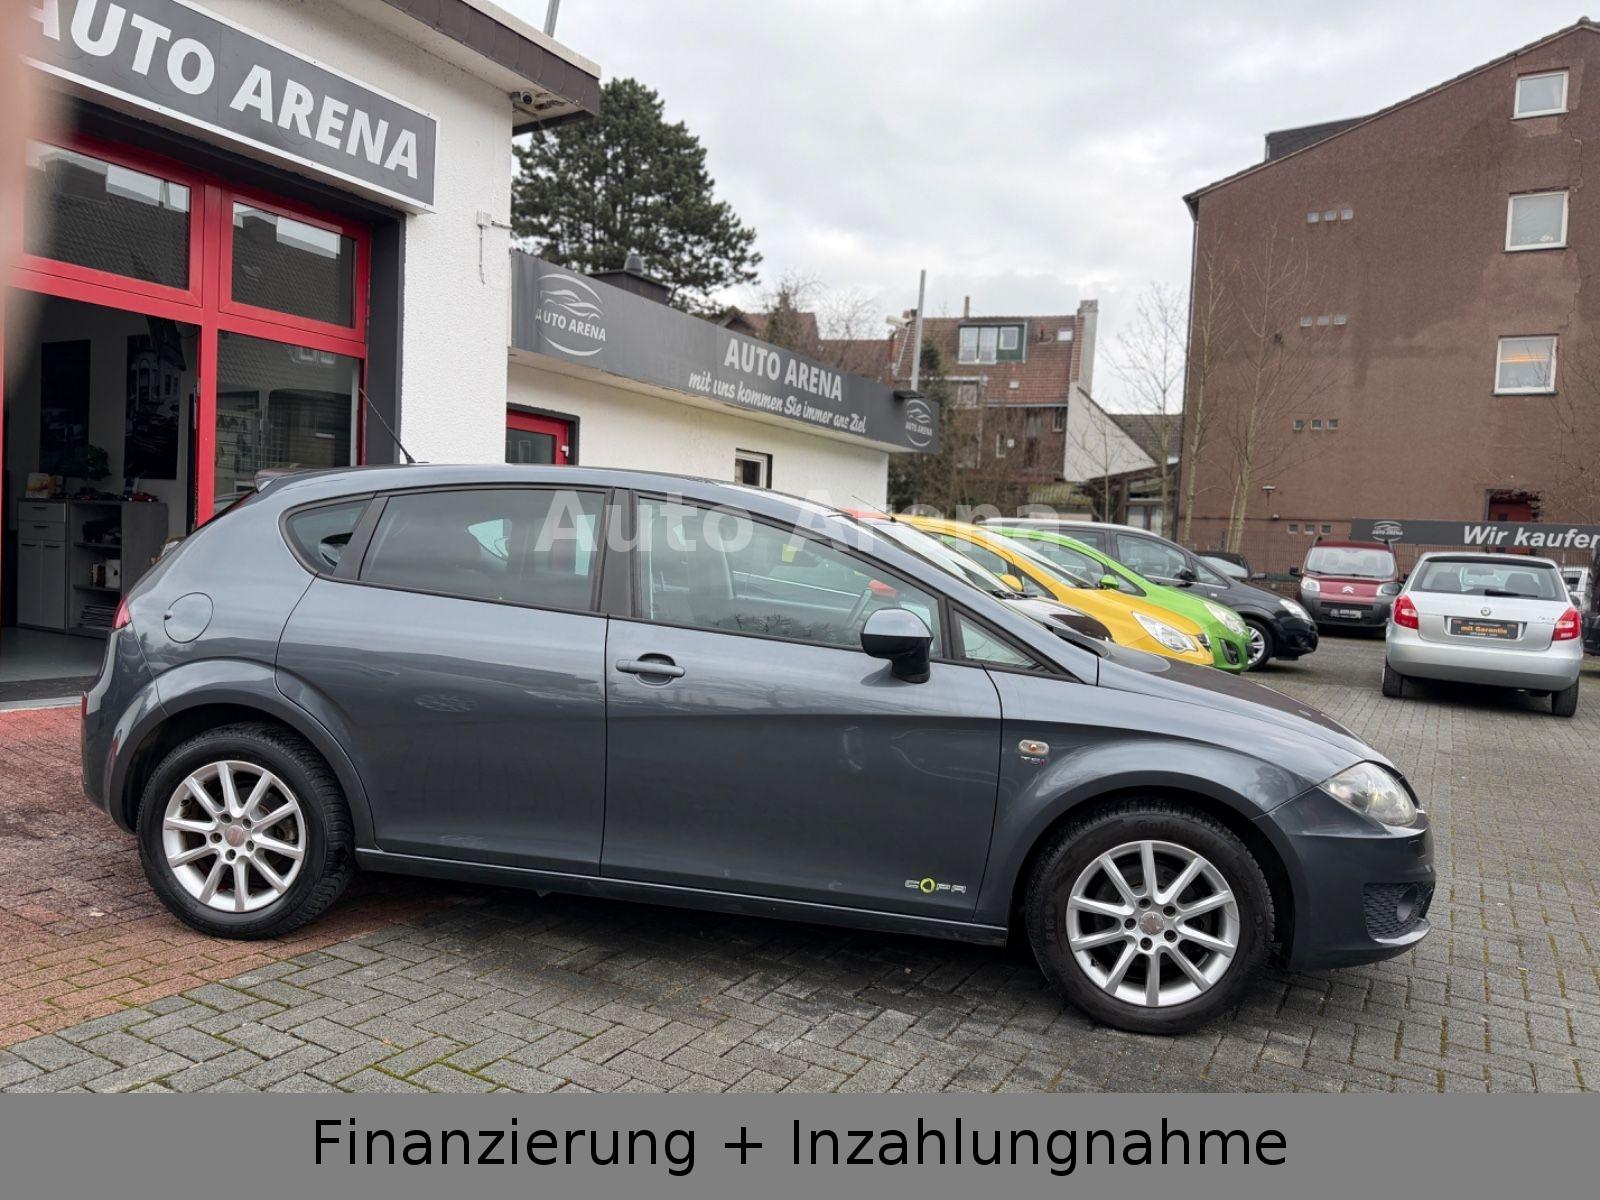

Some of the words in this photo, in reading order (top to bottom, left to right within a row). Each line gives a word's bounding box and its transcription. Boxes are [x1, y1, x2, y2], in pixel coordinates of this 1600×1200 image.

[229, 64, 418, 179] ARENA
[535, 309, 566, 329] AUTO
[568, 319, 606, 341] ARENA
[724, 338, 780, 380] AUTO
[785, 358, 842, 402] ARENA
[688, 371, 711, 392] mit
[713, 379, 736, 399] uns
[737, 381, 783, 413] kommen
[785, 396, 802, 417] Sie
[803, 401, 834, 426] immer
[834, 414, 849, 430] ans
[850, 413, 866, 434] Ziel
[1463, 525, 1509, 545] Wir
